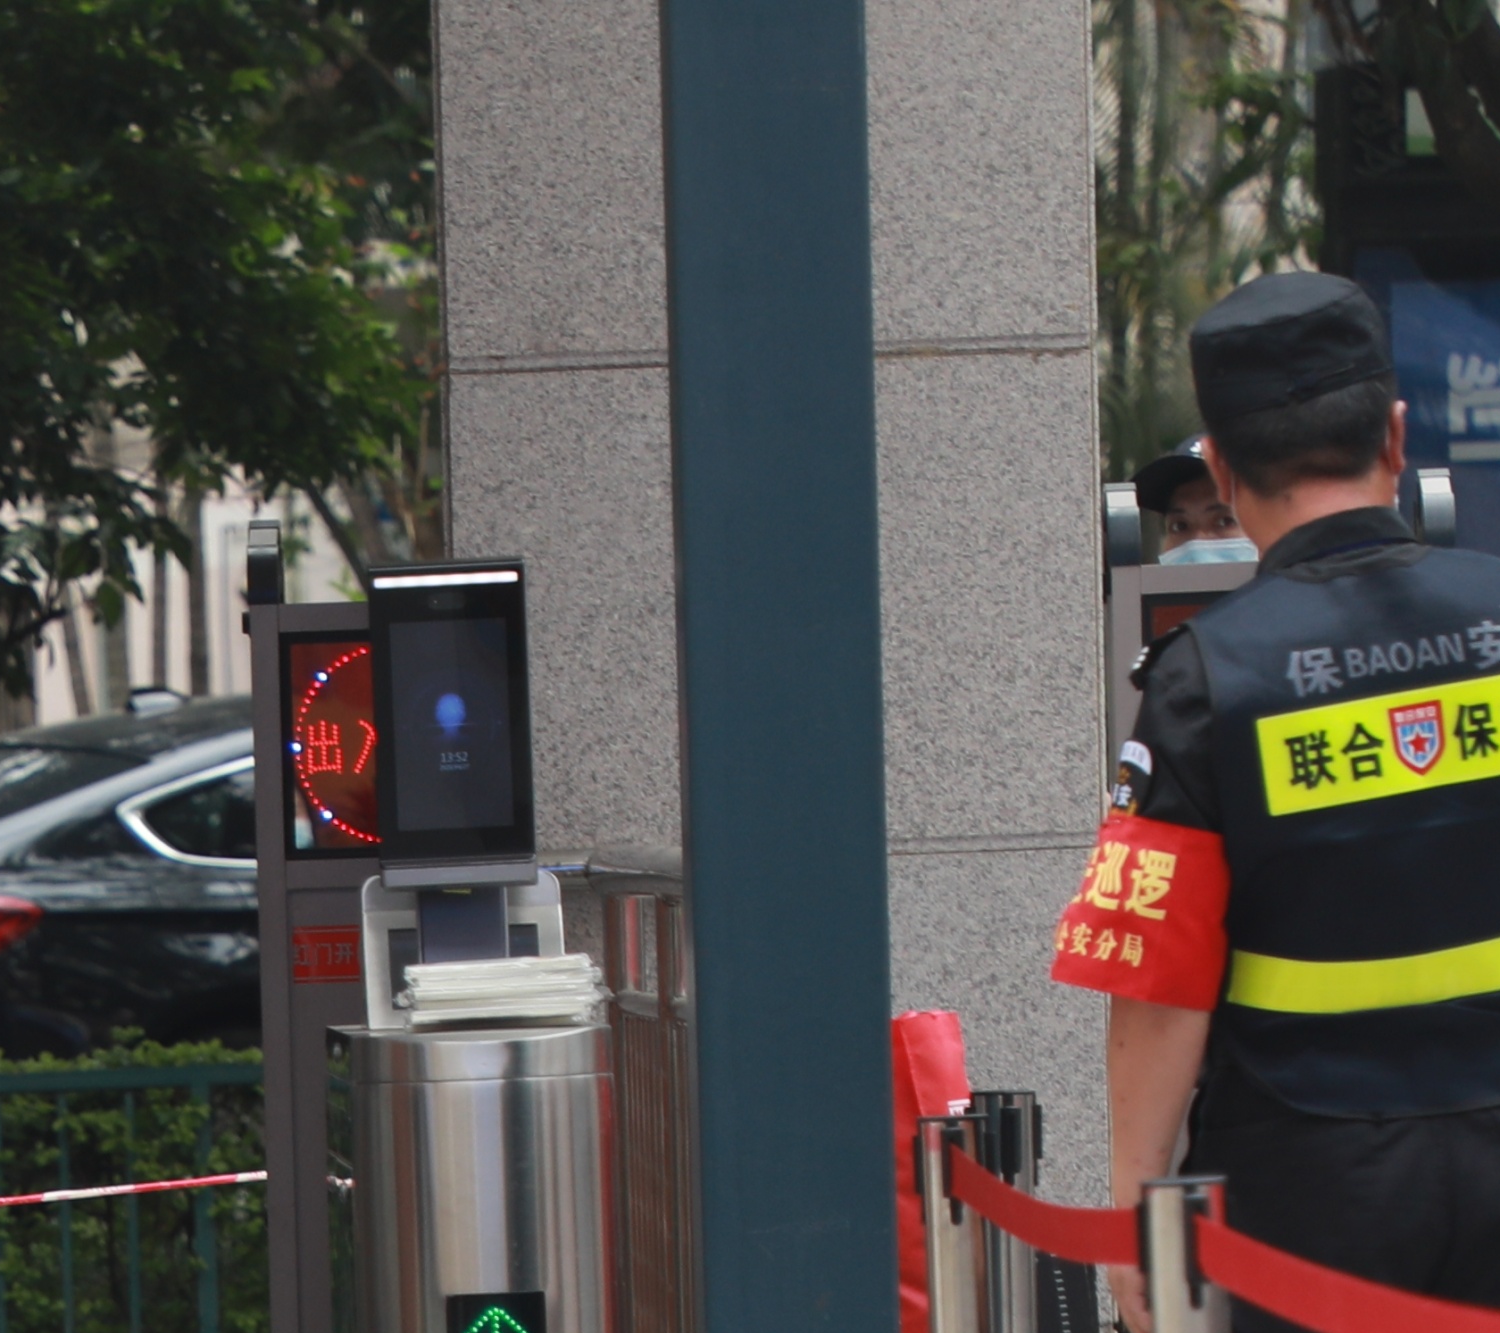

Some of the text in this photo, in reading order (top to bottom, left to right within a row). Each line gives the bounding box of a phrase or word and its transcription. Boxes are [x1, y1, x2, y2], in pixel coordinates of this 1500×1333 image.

[1285, 646, 1343, 698] 保
[1345, 632, 1467, 679] BAOAN
[1284, 722, 1385, 790] 联合
